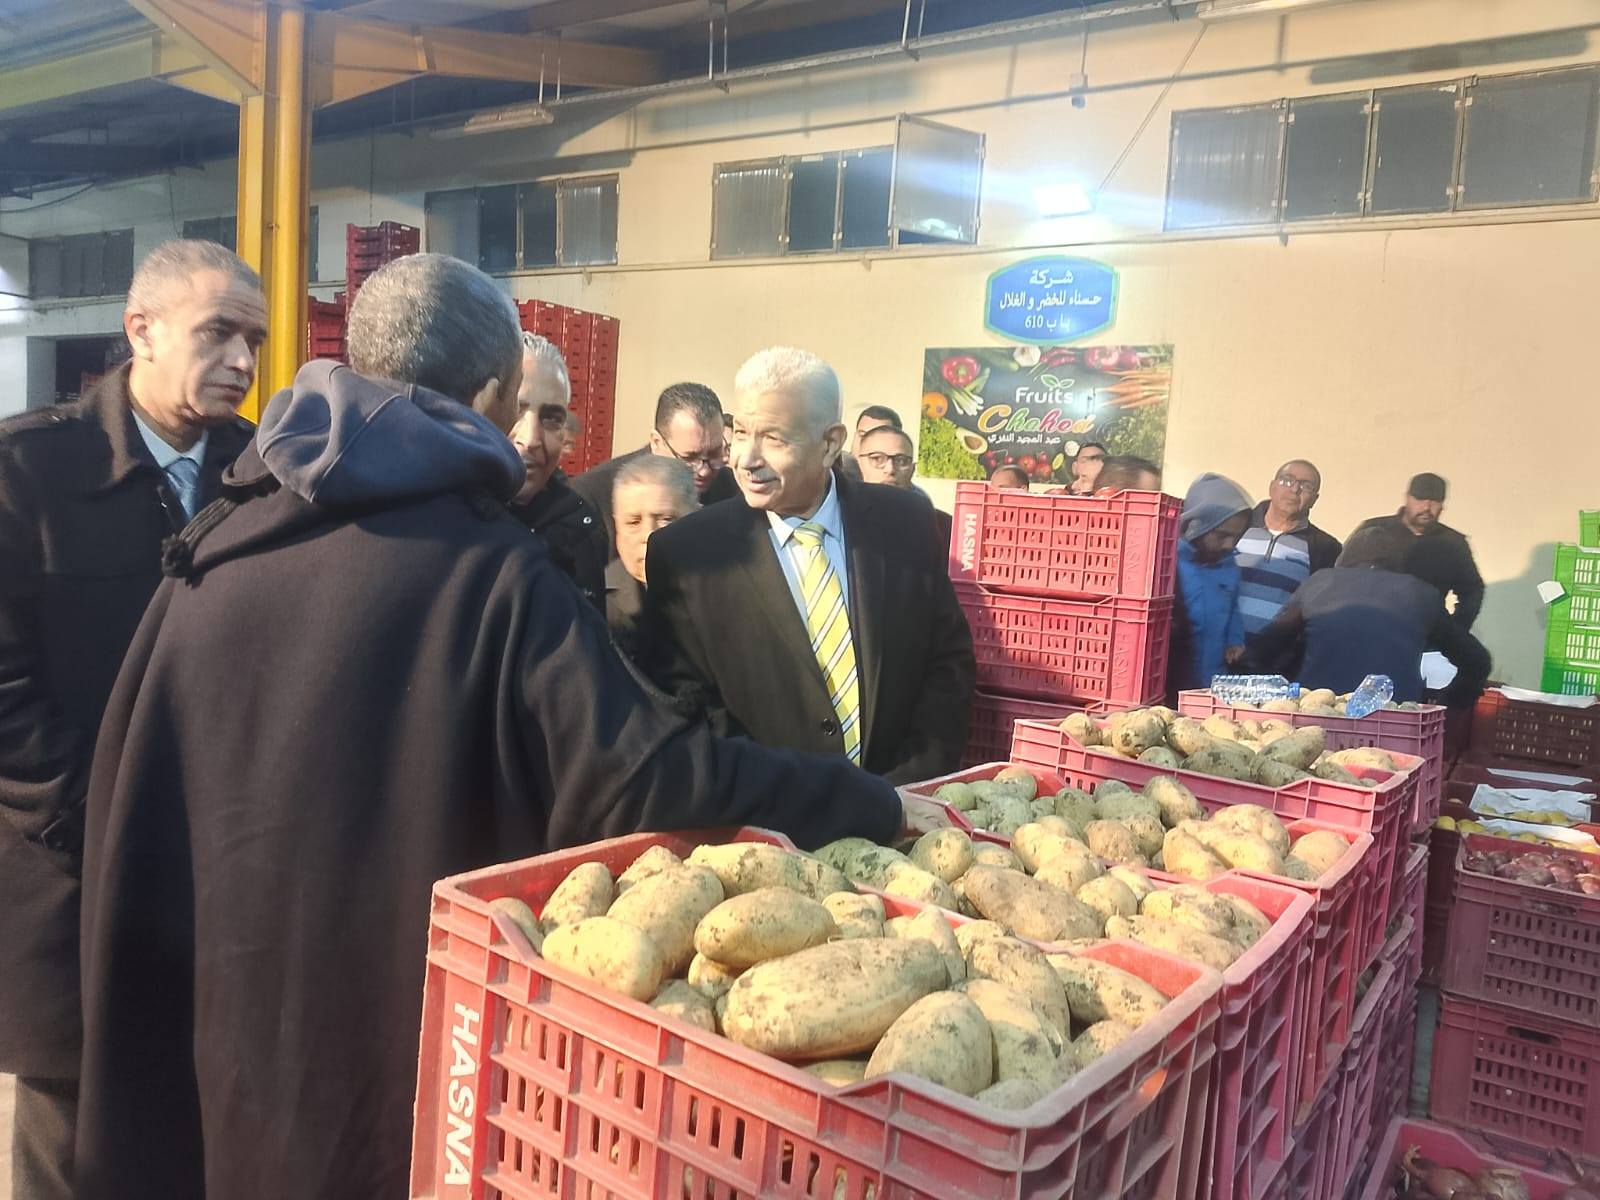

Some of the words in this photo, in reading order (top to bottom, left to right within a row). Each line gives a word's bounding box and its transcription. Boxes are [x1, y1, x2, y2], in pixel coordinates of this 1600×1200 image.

[1029, 269, 1073, 288] شركة
[1000, 292, 1026, 309] الغلال
[1027, 297, 1035, 310] و
[1036, 290, 1067, 311] للخضر
[1068, 290, 1102, 305] حسناء
[1024, 315, 1044, 329] 610
[1015, 387, 1074, 404] Fruits
[978, 404, 1096, 433] Chahed
[961, 513, 978, 572] HASNA
[445, 1002, 480, 1185] HASNA
